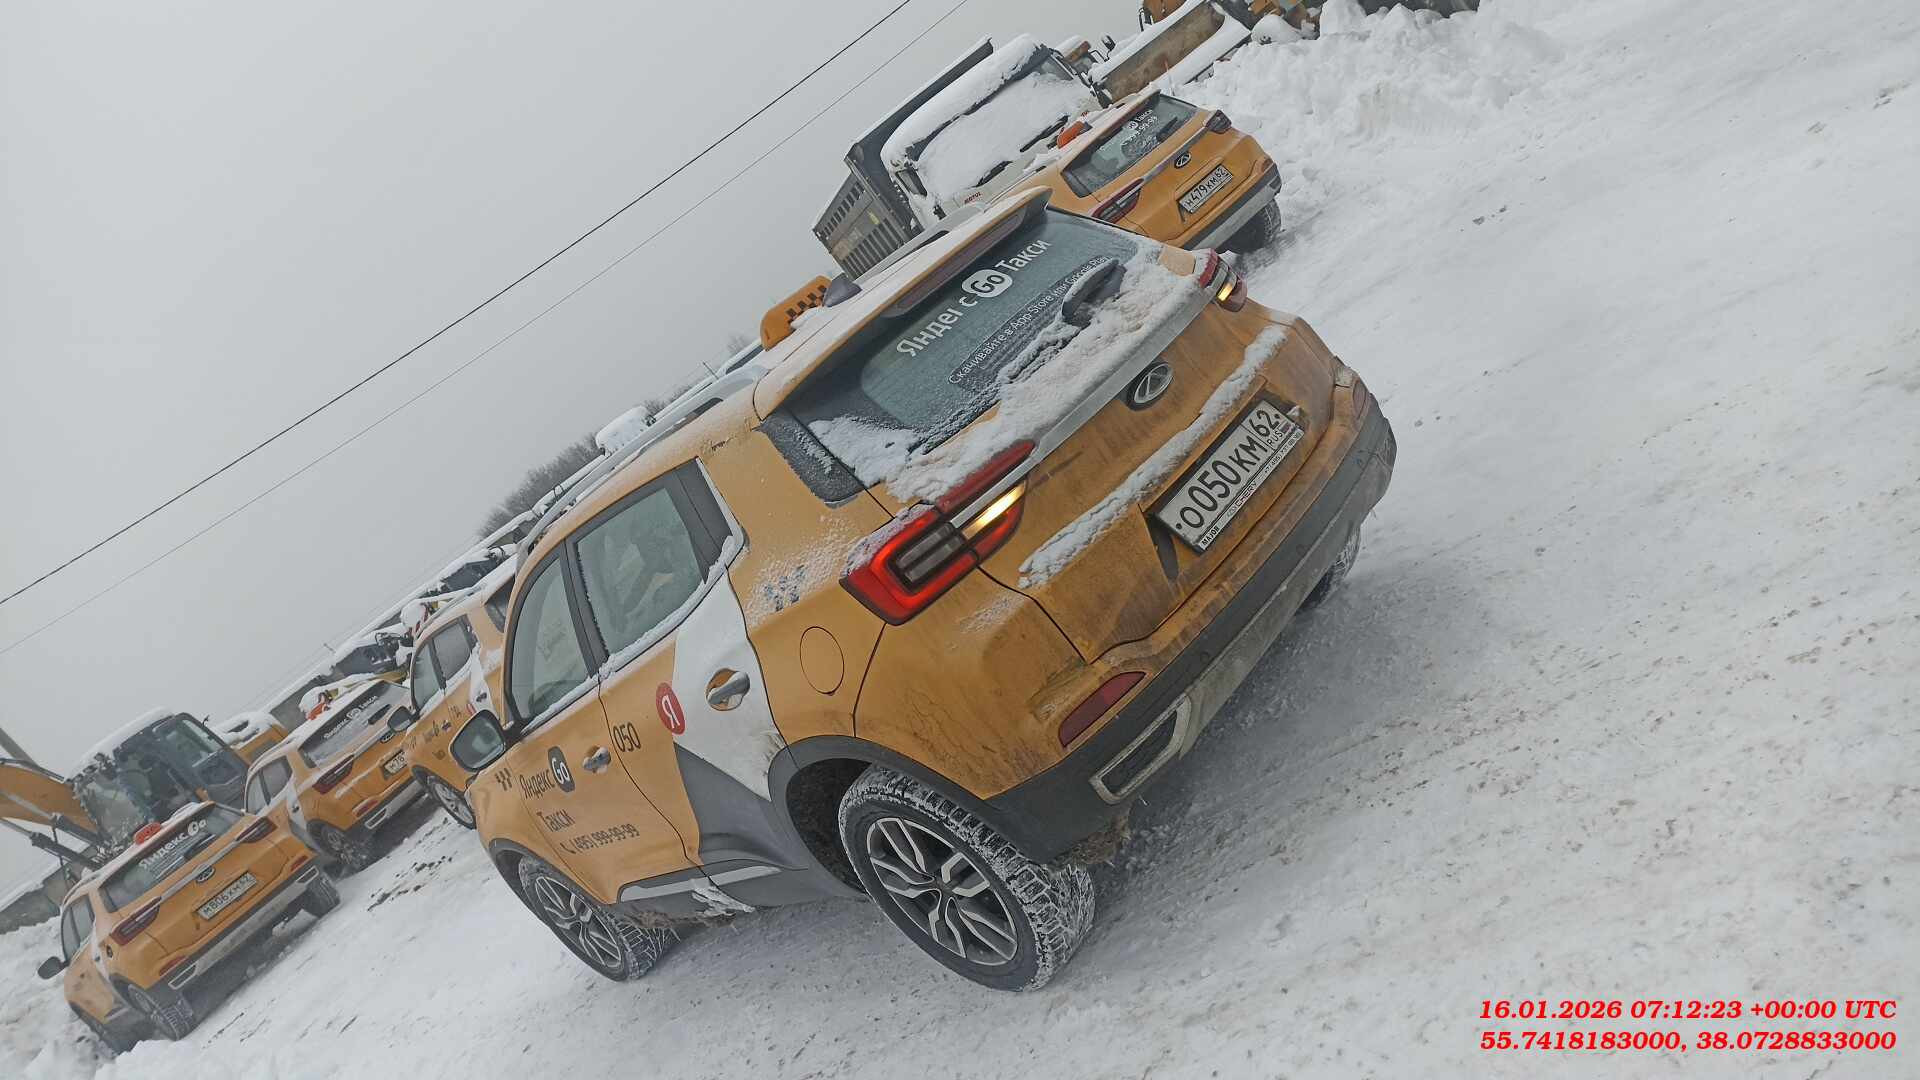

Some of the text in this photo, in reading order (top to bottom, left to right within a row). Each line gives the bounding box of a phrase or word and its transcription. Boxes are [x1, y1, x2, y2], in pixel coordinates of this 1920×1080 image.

[896, 294, 979, 358] Яндес
[994, 239, 1054, 274] Такси
[949, 332, 1007, 385] Скачивайте
[1011, 311, 1033, 335] App
[1030, 293, 1056, 315] Store
[1266, 430, 1284, 447] RUS
[1179, 408, 1280, 530] О050КМ 62
[1201, 525, 1220, 546] MAJOR
[613, 721, 641, 753] 050
[518, 768, 556, 801] Яндекс
[536, 807, 577, 833] Такси
[138, 832, 187, 870] Яндекс
[570, 822, 641, 855] (495) 999-99-99
